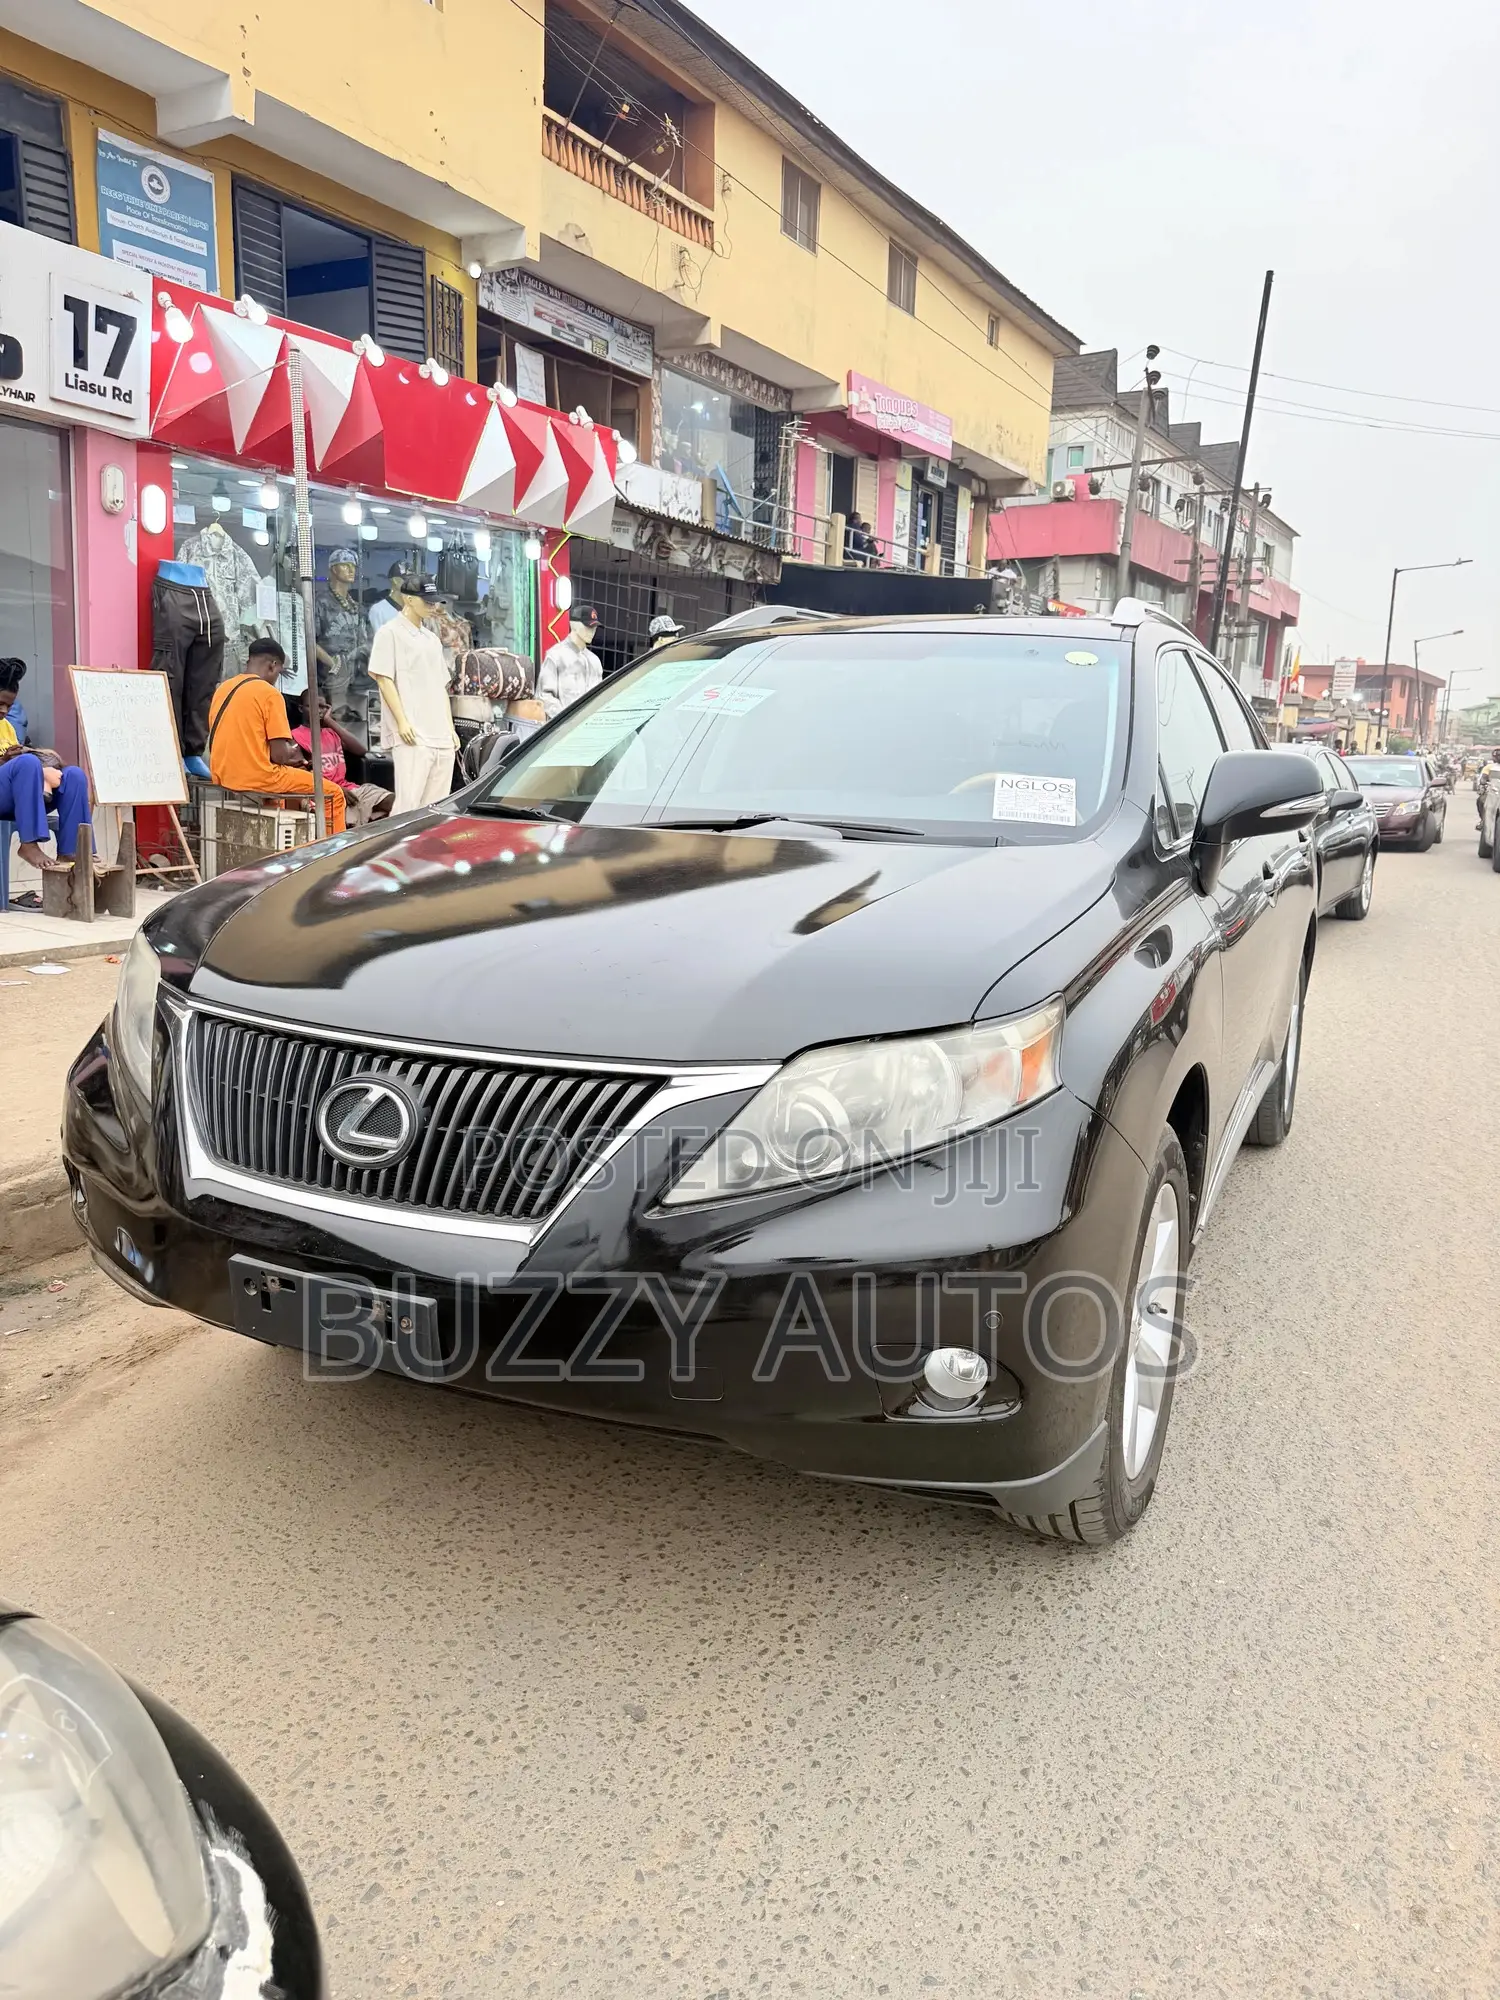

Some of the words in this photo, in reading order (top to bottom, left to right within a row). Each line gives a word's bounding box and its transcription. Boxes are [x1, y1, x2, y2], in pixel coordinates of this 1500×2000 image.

[126, 205, 141, 217] Place
[151, 213, 189, 233] Transformation
[127, 220, 145, 231] Church
[523, 275, 548, 294] EAGLE'S
[549, 286, 562, 300] WAY
[586, 305, 613, 324] ACADEMY
[64, 294, 137, 380] 17
[65, 372, 107, 398] Liasu
[112, 385, 133, 404] Rd
[875, 393, 919, 417] Tongues
[1001, 779, 1071, 793] NGLOS
